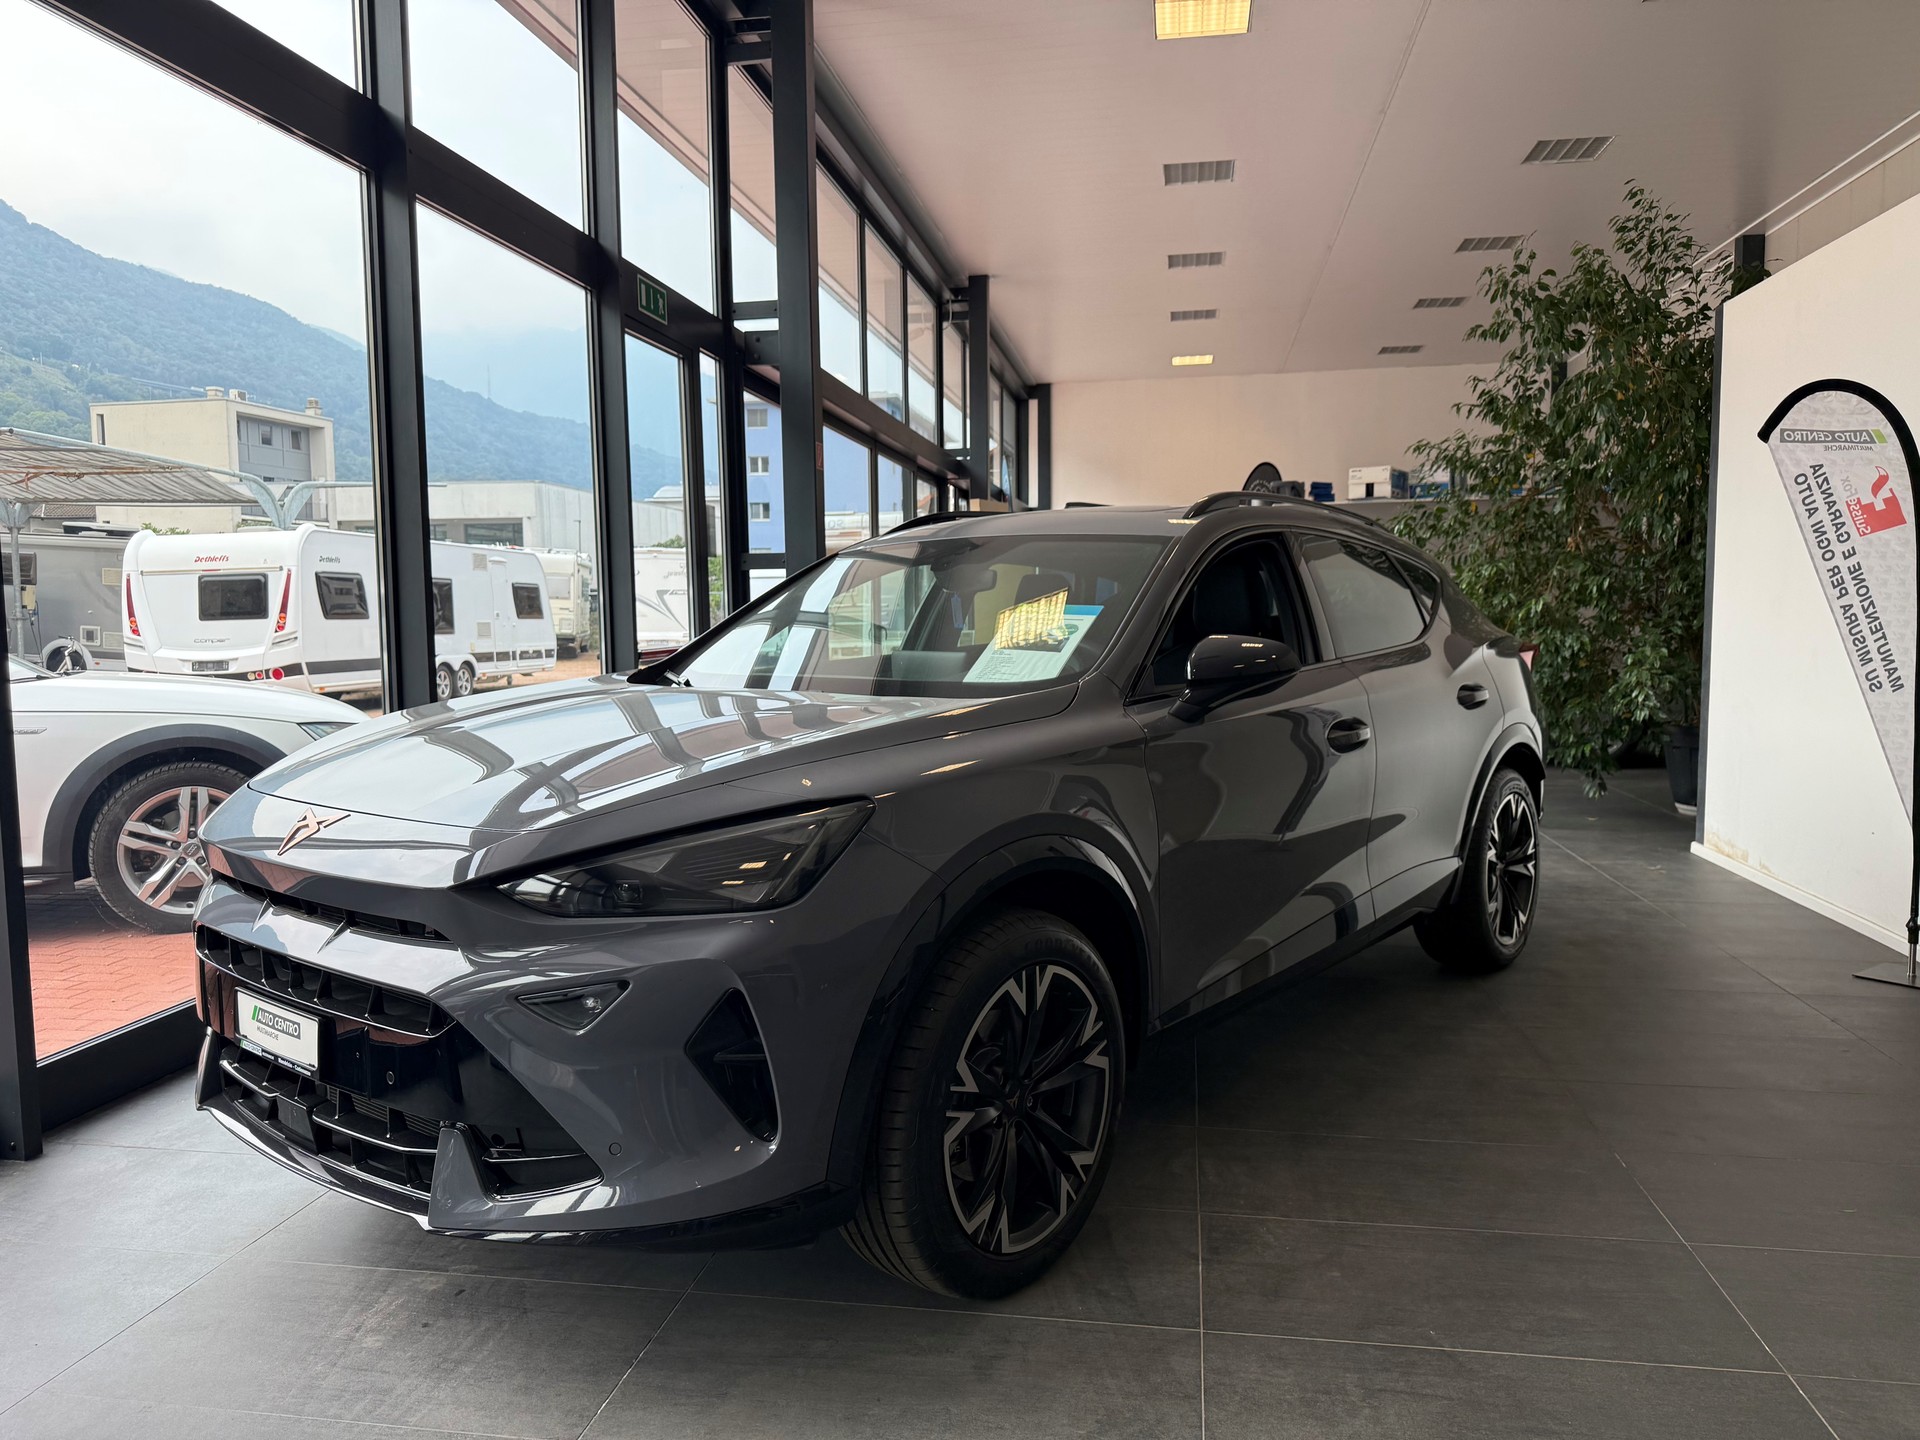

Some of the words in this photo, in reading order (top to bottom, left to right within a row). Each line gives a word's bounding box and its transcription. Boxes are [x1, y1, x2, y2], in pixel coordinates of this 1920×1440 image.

[194, 554, 230, 564] Dethleffs
[258, 1010, 274, 1026] AUTO
[274, 1017, 299, 1036] CENTRO
